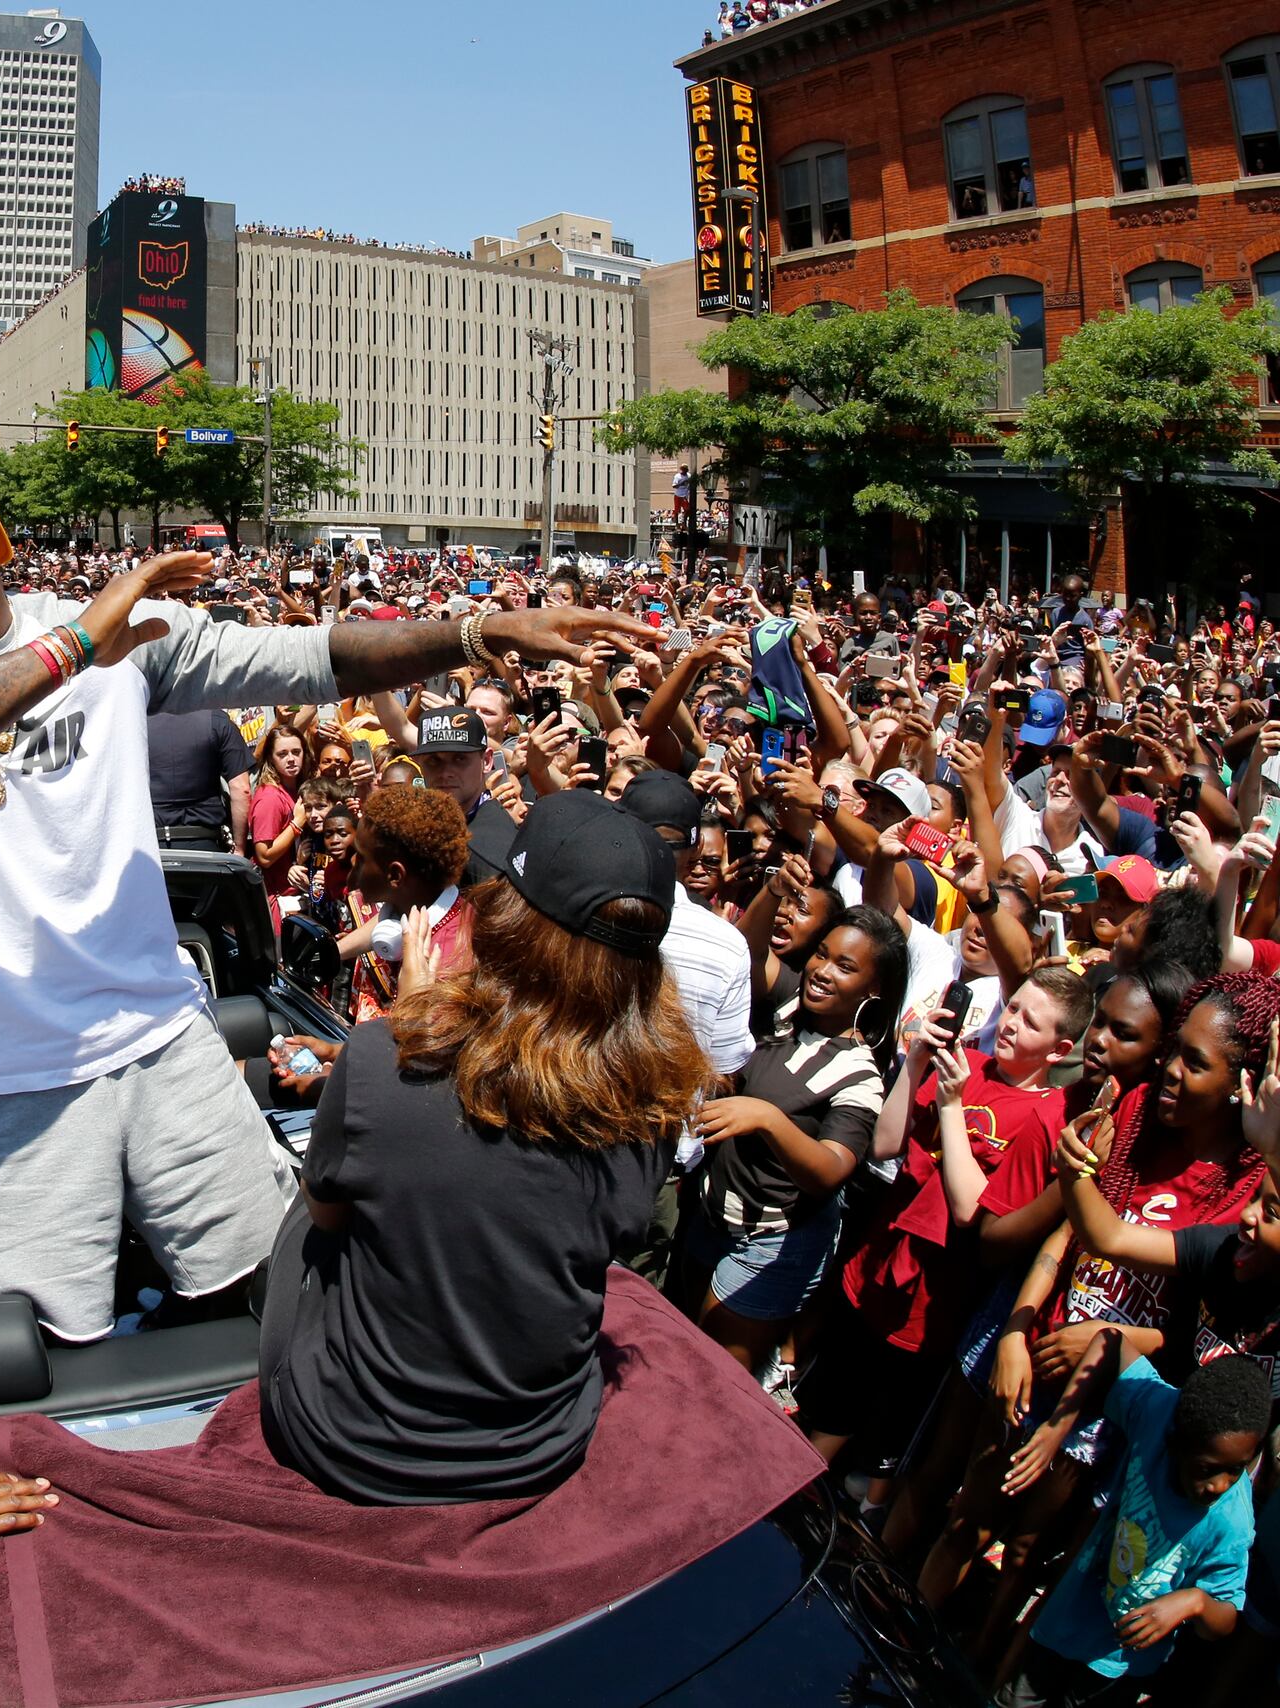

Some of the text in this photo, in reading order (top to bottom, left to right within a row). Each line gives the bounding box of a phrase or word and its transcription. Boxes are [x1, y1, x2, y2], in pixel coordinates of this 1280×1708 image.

[40, 22, 67, 47] 9
[690, 85, 722, 291] BRICKSTONE
[699, 294, 730, 308] TAVERN
[191, 430, 228, 442] Bolivar
[427, 716, 451, 731] NBA
[21, 710, 88, 775] AIR
[427, 730, 469, 743] CHAMPS
[1070, 1289, 1127, 1326] CLEVELA
